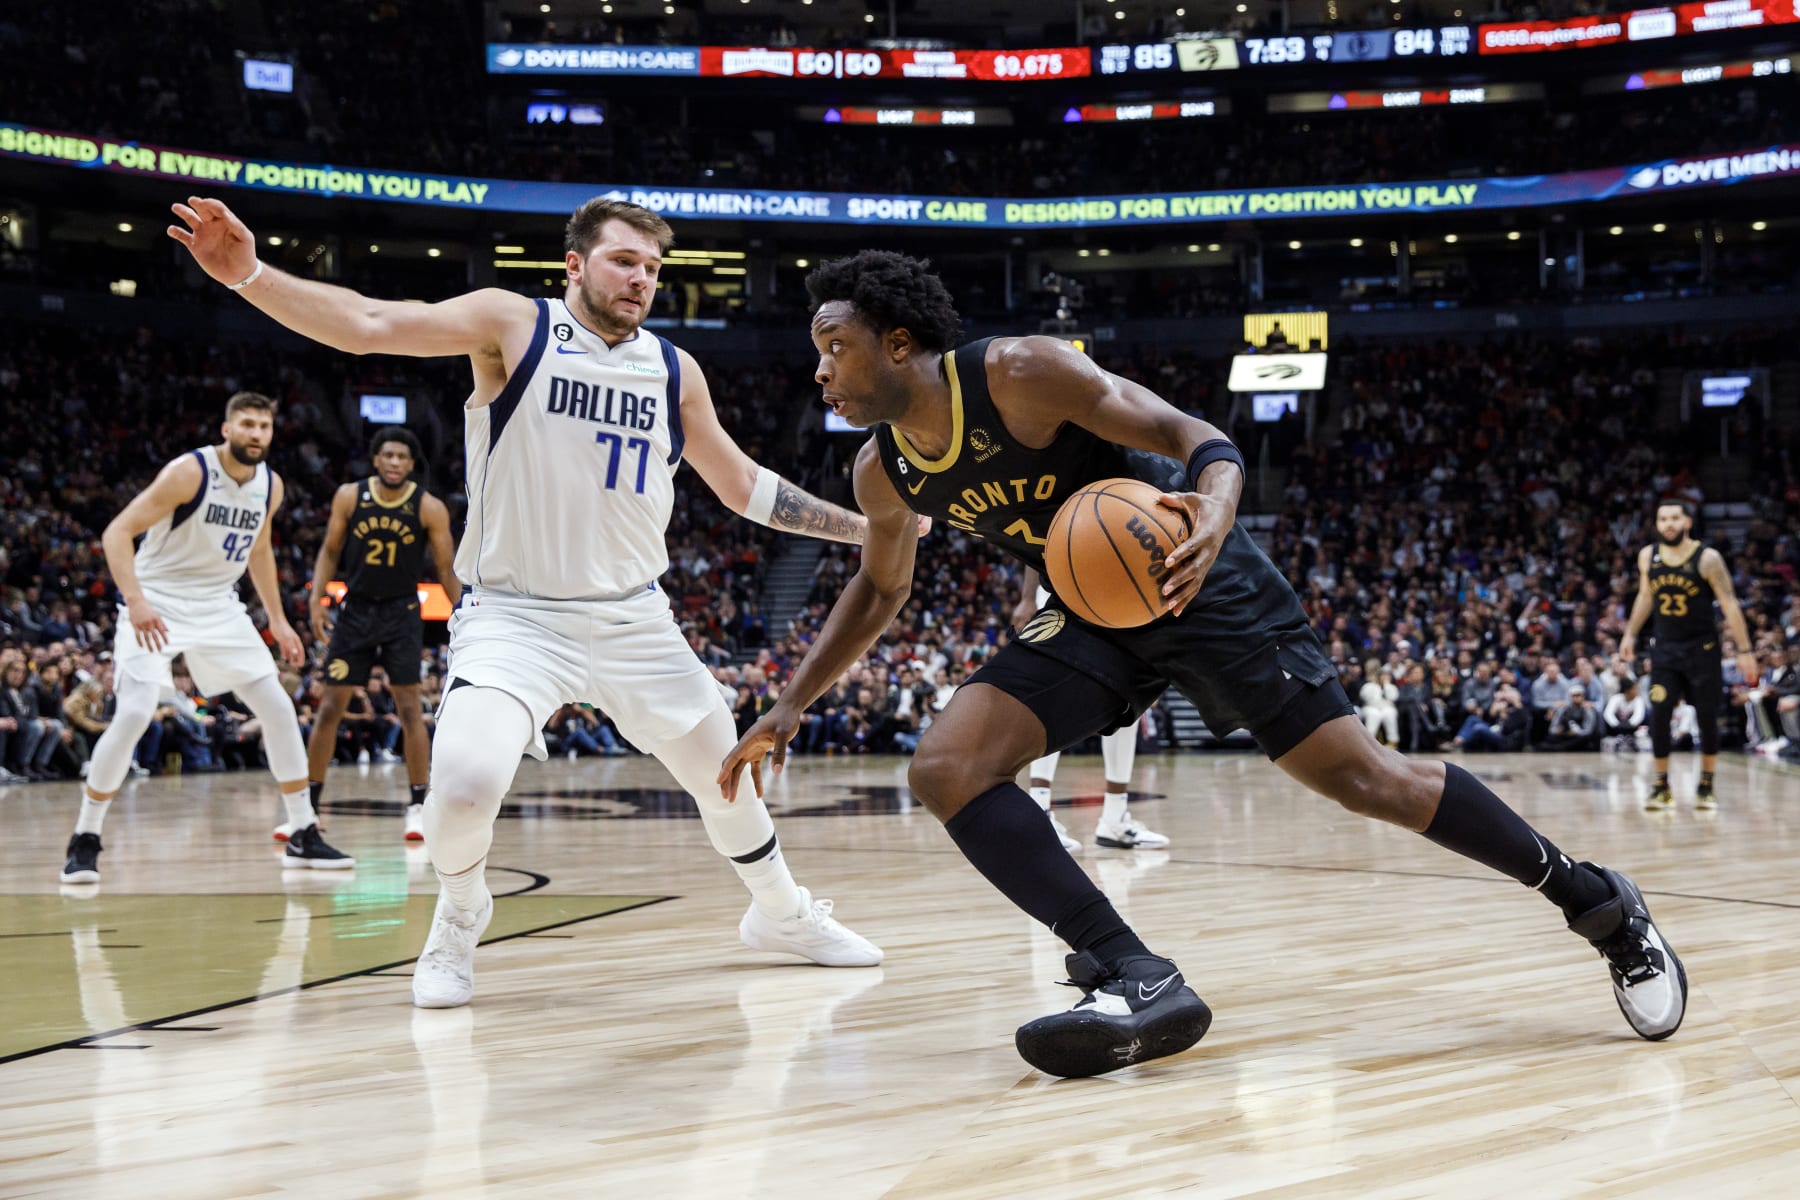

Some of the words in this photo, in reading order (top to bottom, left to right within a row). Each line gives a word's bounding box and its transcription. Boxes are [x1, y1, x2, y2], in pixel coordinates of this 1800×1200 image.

[1245, 36, 1305, 63] 7:53
[1394, 29, 1434, 55] 84
[524, 49, 579, 67] DOVE
[994, 54, 1063, 79] $9,675
[1134, 44, 1172, 69] 85
[102, 143, 157, 171] FOR
[159, 151, 242, 182] EVERY
[245, 163, 363, 194] POSITION
[368, 174, 421, 198] YOU
[425, 179, 488, 204] PLAY
[1662, 158, 1729, 186] DOVE
[631, 191, 696, 213] DOVE
[697, 193, 830, 217] MEN+CARE
[847, 198, 922, 220] SPORT
[926, 201, 987, 222] CARE
[1005, 202, 1117, 223] DESIGNED
[1120, 198, 1167, 219] FOR
[1171, 195, 1245, 217] EVERY
[1249, 191, 1358, 213] POSITION
[1360, 187, 1412, 208] YOU
[1414, 184, 1478, 206] PLAY
[548, 376, 657, 431] DALLAS
[596, 431, 650, 494] 77
[896, 456, 908, 475] 6
[974, 452, 990, 463] Sun
[205, 503, 261, 530] DALLAS
[948, 475, 1057, 538] ORONTO
[353, 515, 415, 545] TORONTO
[222, 532, 254, 561] 42
[365, 538, 397, 568] 21
[1659, 593, 1688, 617] 23
